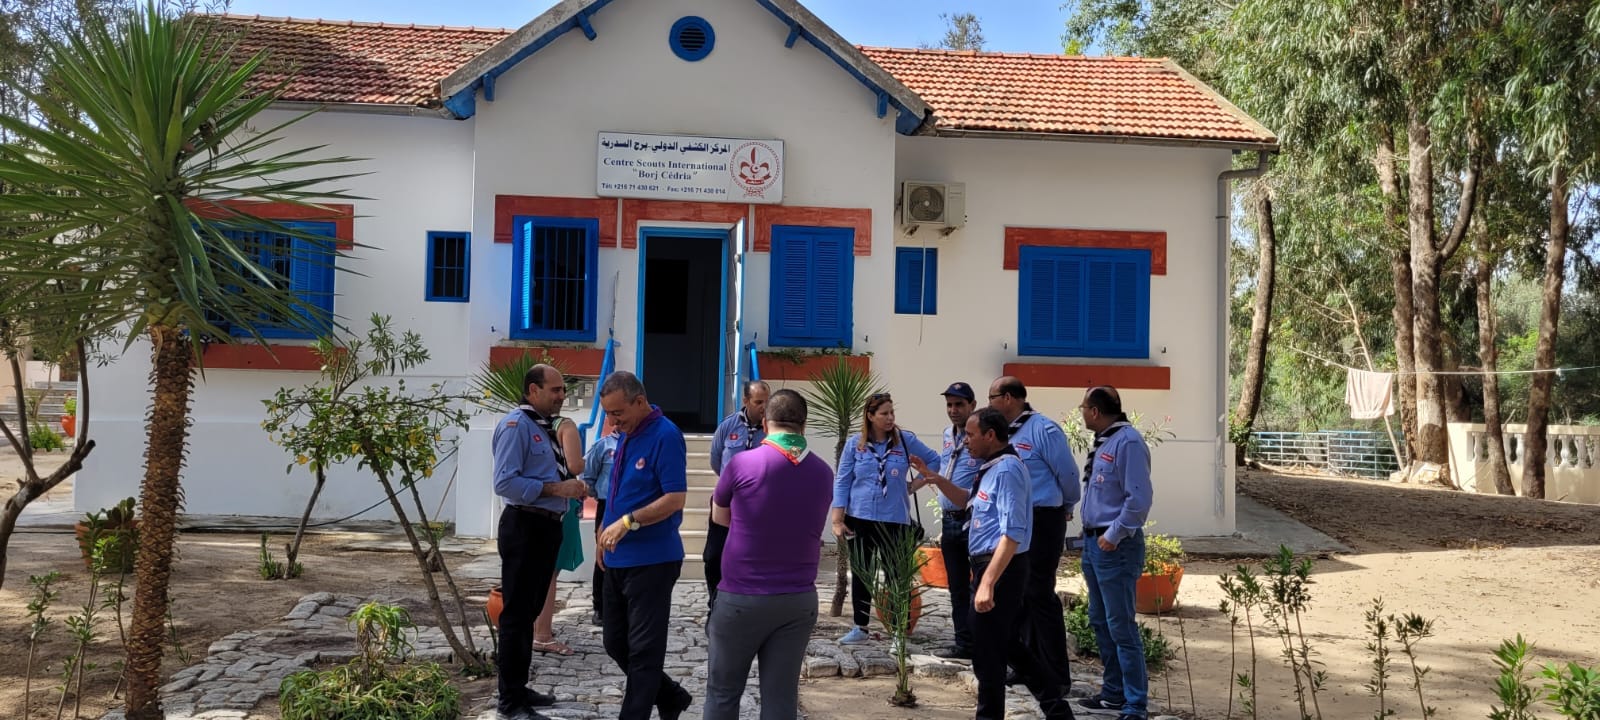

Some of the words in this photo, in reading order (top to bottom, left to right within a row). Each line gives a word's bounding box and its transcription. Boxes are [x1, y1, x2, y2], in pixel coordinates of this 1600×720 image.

[601, 137, 632, 150] السدرية
[680, 142, 708, 155] الكشفي
[709, 143, 730, 155] المركز
[603, 157, 634, 167] Centre
[636, 159, 666, 168] Scouts
[668, 160, 727, 171] International
